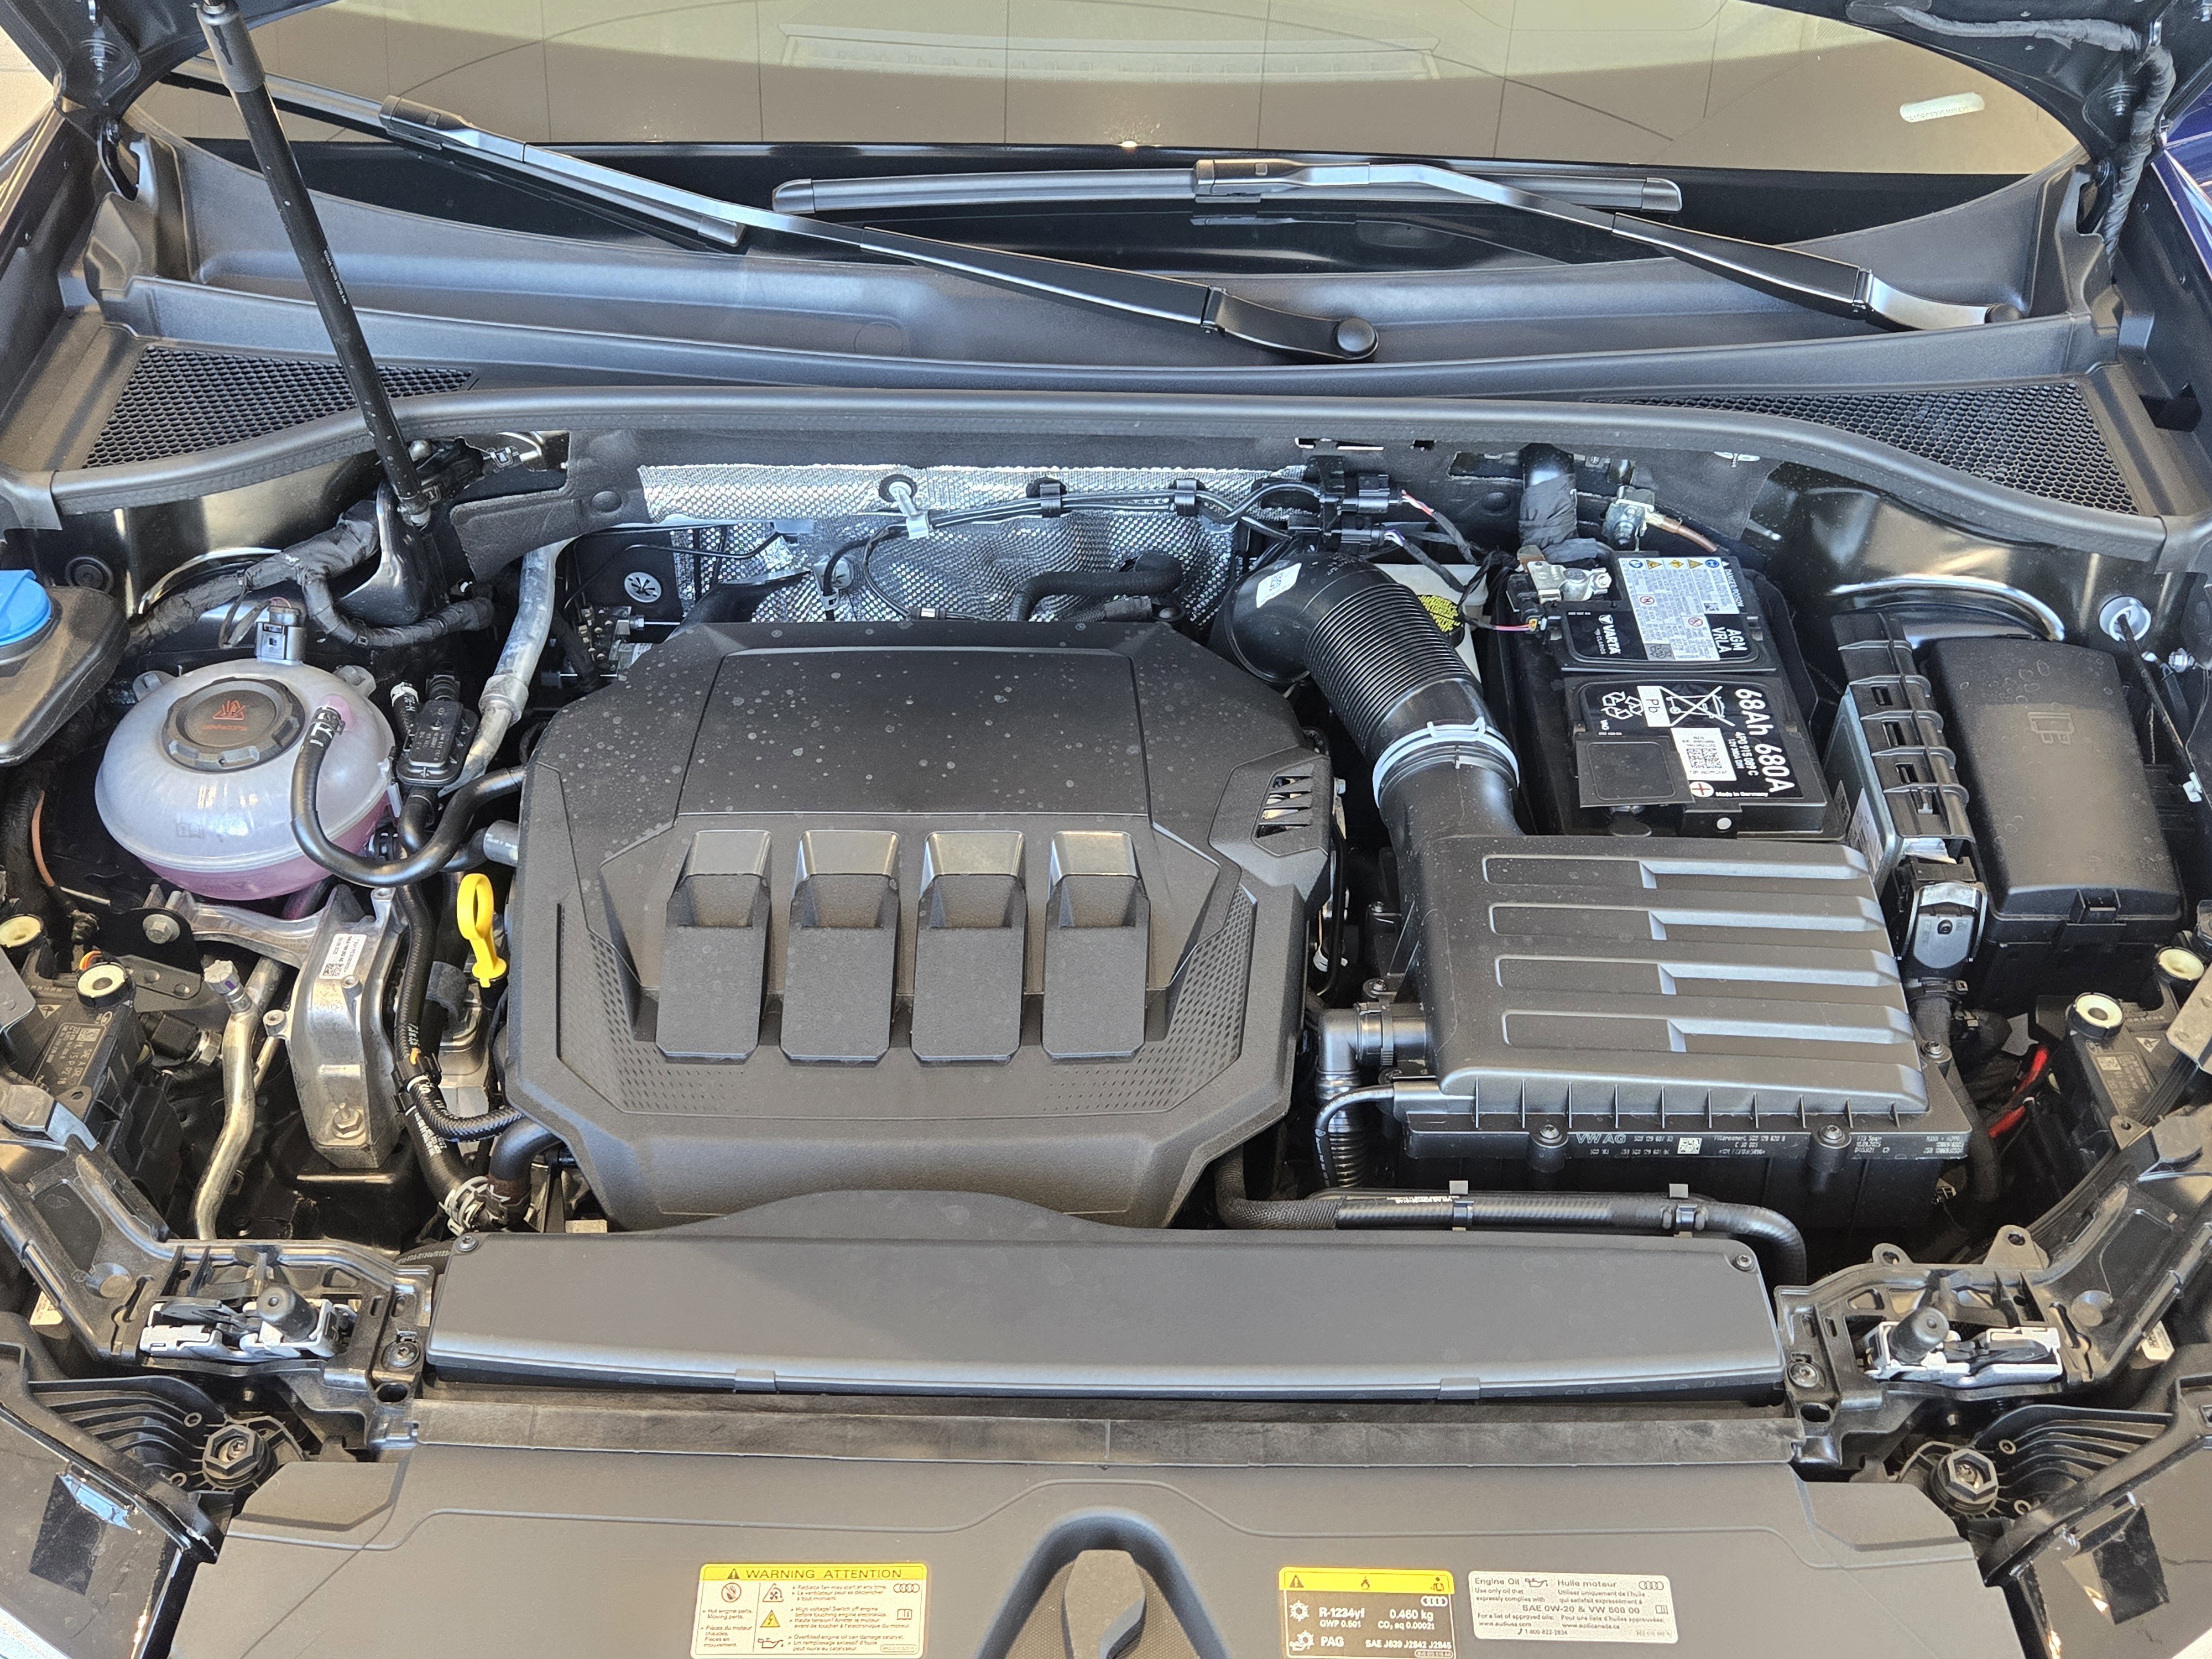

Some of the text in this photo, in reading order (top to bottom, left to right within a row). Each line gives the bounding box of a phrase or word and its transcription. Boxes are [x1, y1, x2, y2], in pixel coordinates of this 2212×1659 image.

[1733, 588, 1744, 607] POISON
[1603, 624, 1621, 655] VARTA
[1712, 627, 1732, 653] VRLA
[1726, 629, 1747, 651] AGM
[1645, 697, 1661, 713] Pb
[1735, 688, 1795, 793] 68Ah 680A
[1741, 745, 1753, 757] 915
[1576, 1133, 1626, 1144] VW AG
[746, 1569, 901, 1579] WARNING ATTENTION
[1318, 1607, 1365, 1619] R-1234yf
[1421, 1609, 1434, 1622] kg
[1320, 1636, 1344, 1647] PAG
[1365, 1639, 1382, 1648] SAE
